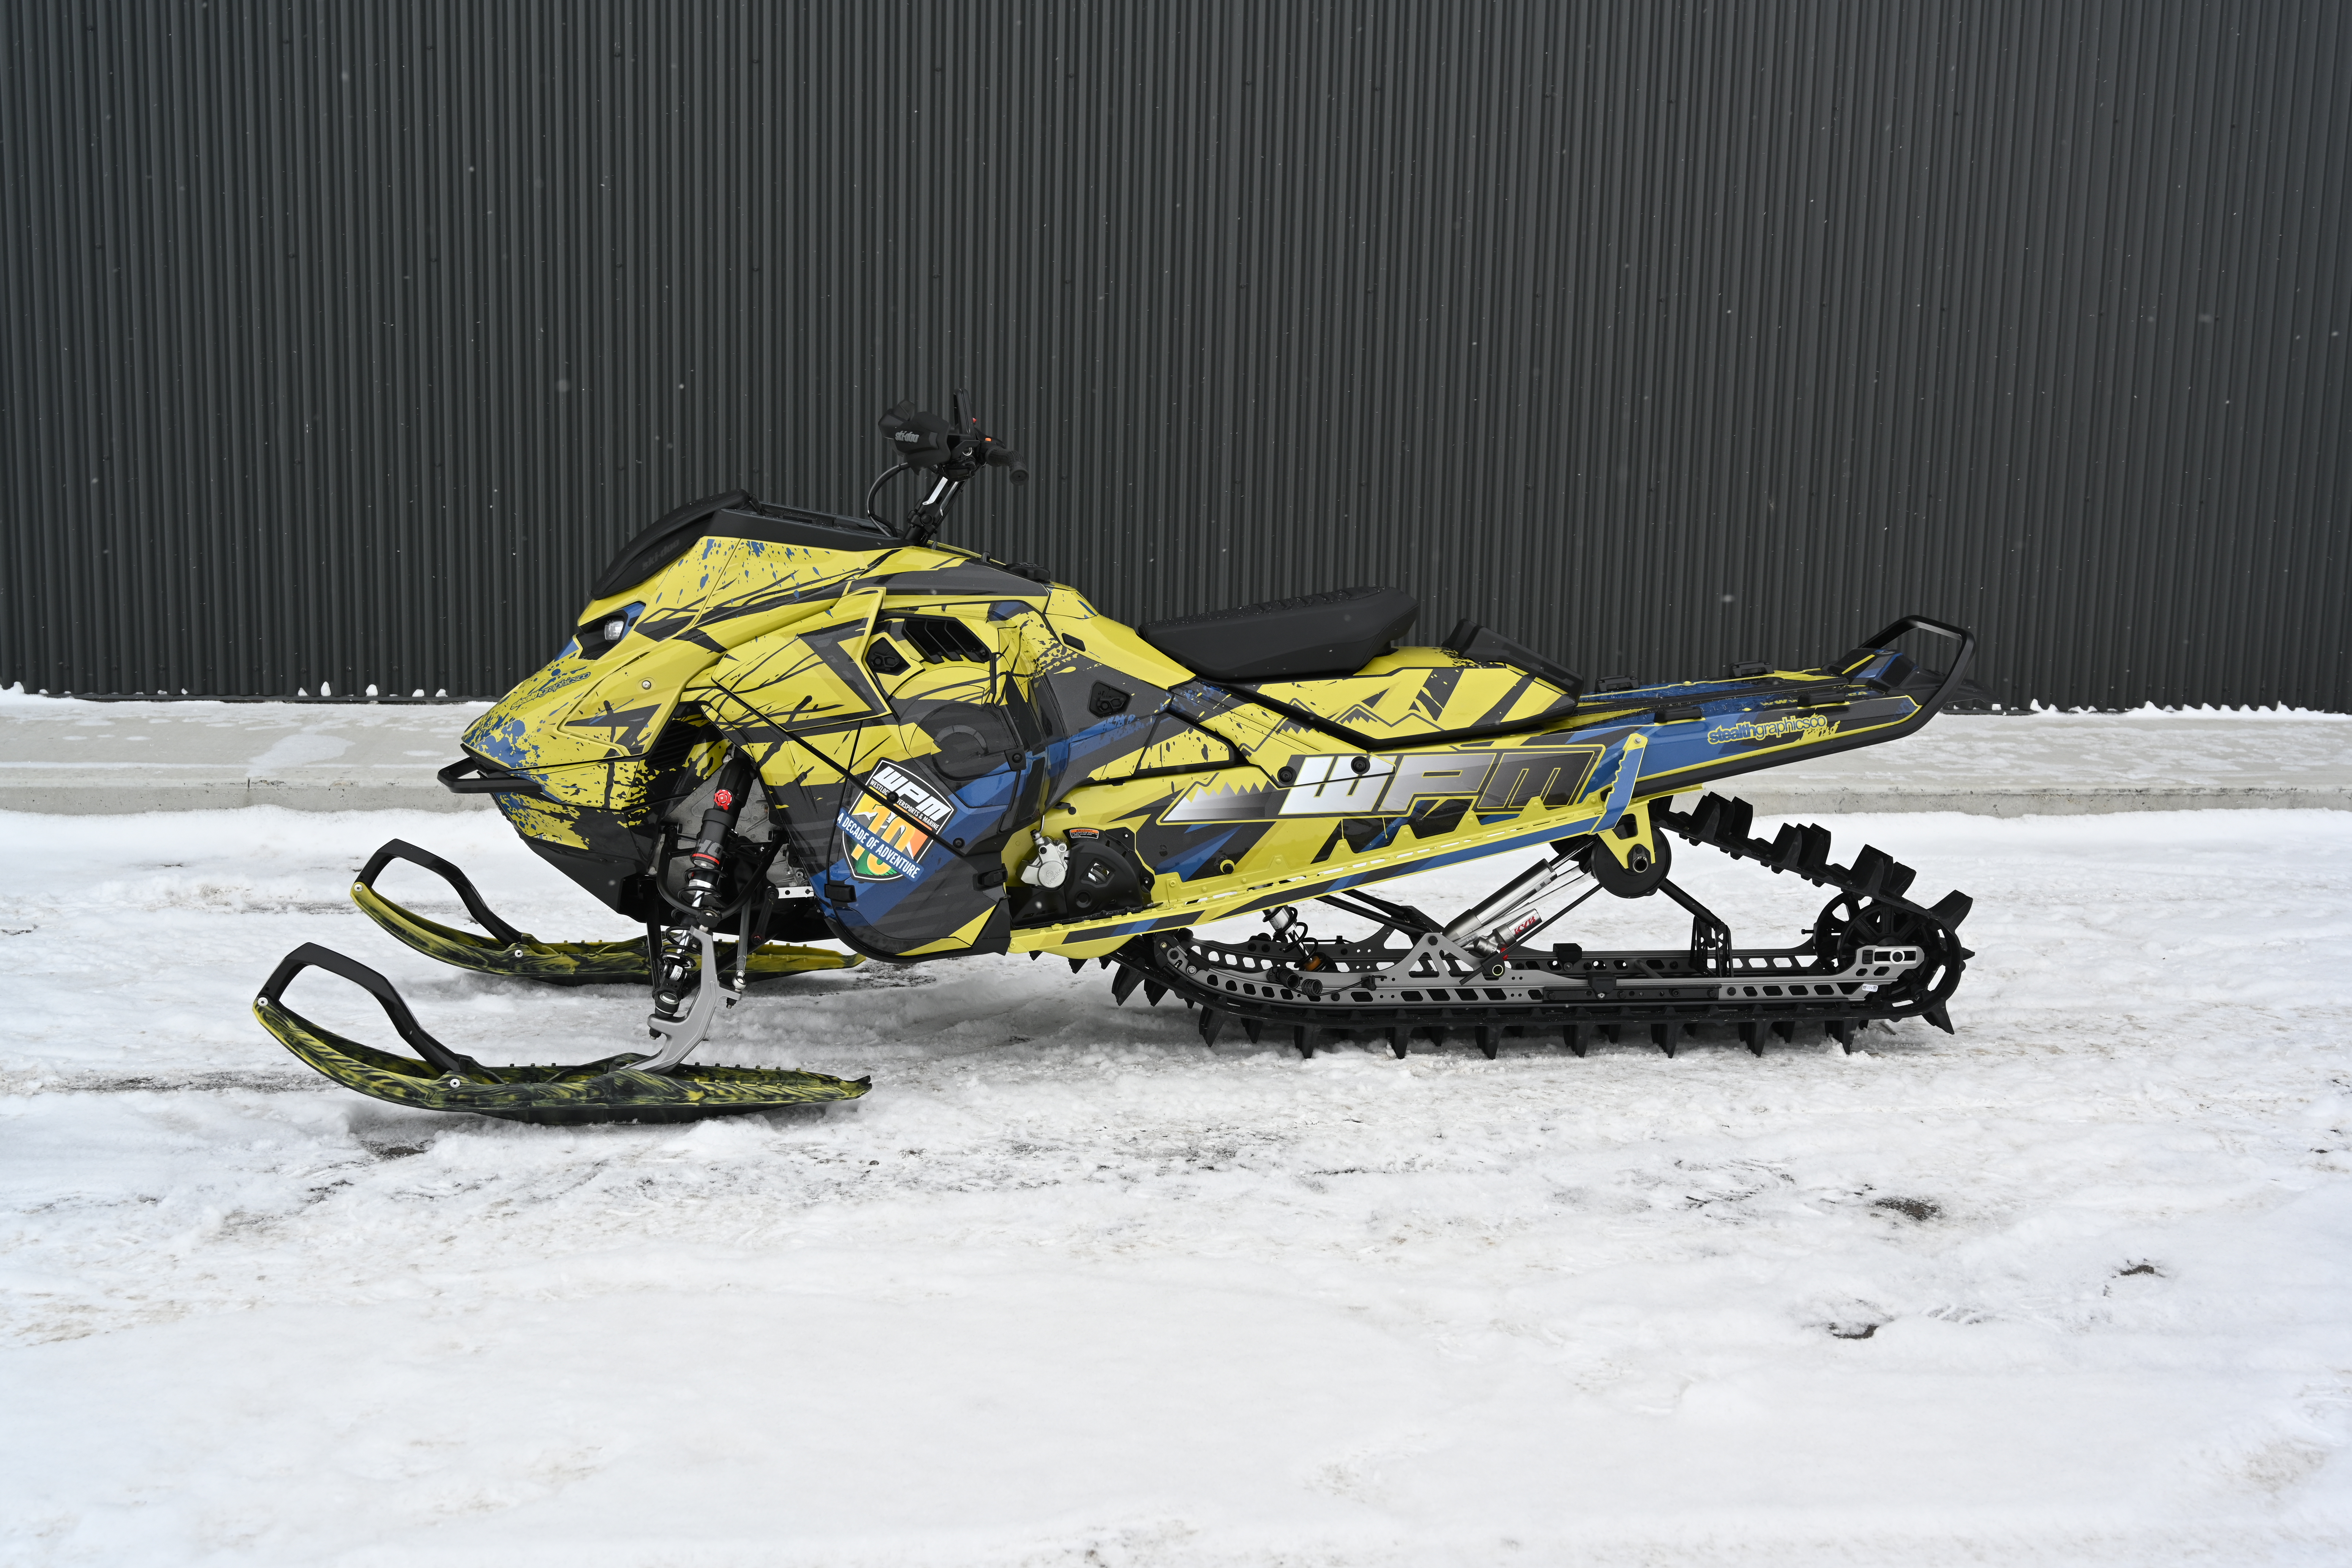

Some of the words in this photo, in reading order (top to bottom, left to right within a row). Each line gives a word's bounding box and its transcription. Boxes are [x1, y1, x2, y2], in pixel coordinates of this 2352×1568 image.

[895, 430, 919, 443] ski-doo
[510, 672, 591, 710] stealthgraphicsco
[1709, 716, 1826, 743] stealthgraphicsco
[870, 779, 890, 796] WESTLOC
[921, 816, 940, 831] MARINE
[873, 766, 952, 821] WPM
[837, 812, 844, 824] A
[842, 817, 869, 844] DECADE
[866, 837, 879, 850] OF
[875, 844, 920, 879] ADVENTURE
[1514, 916, 1536, 935] KYB
